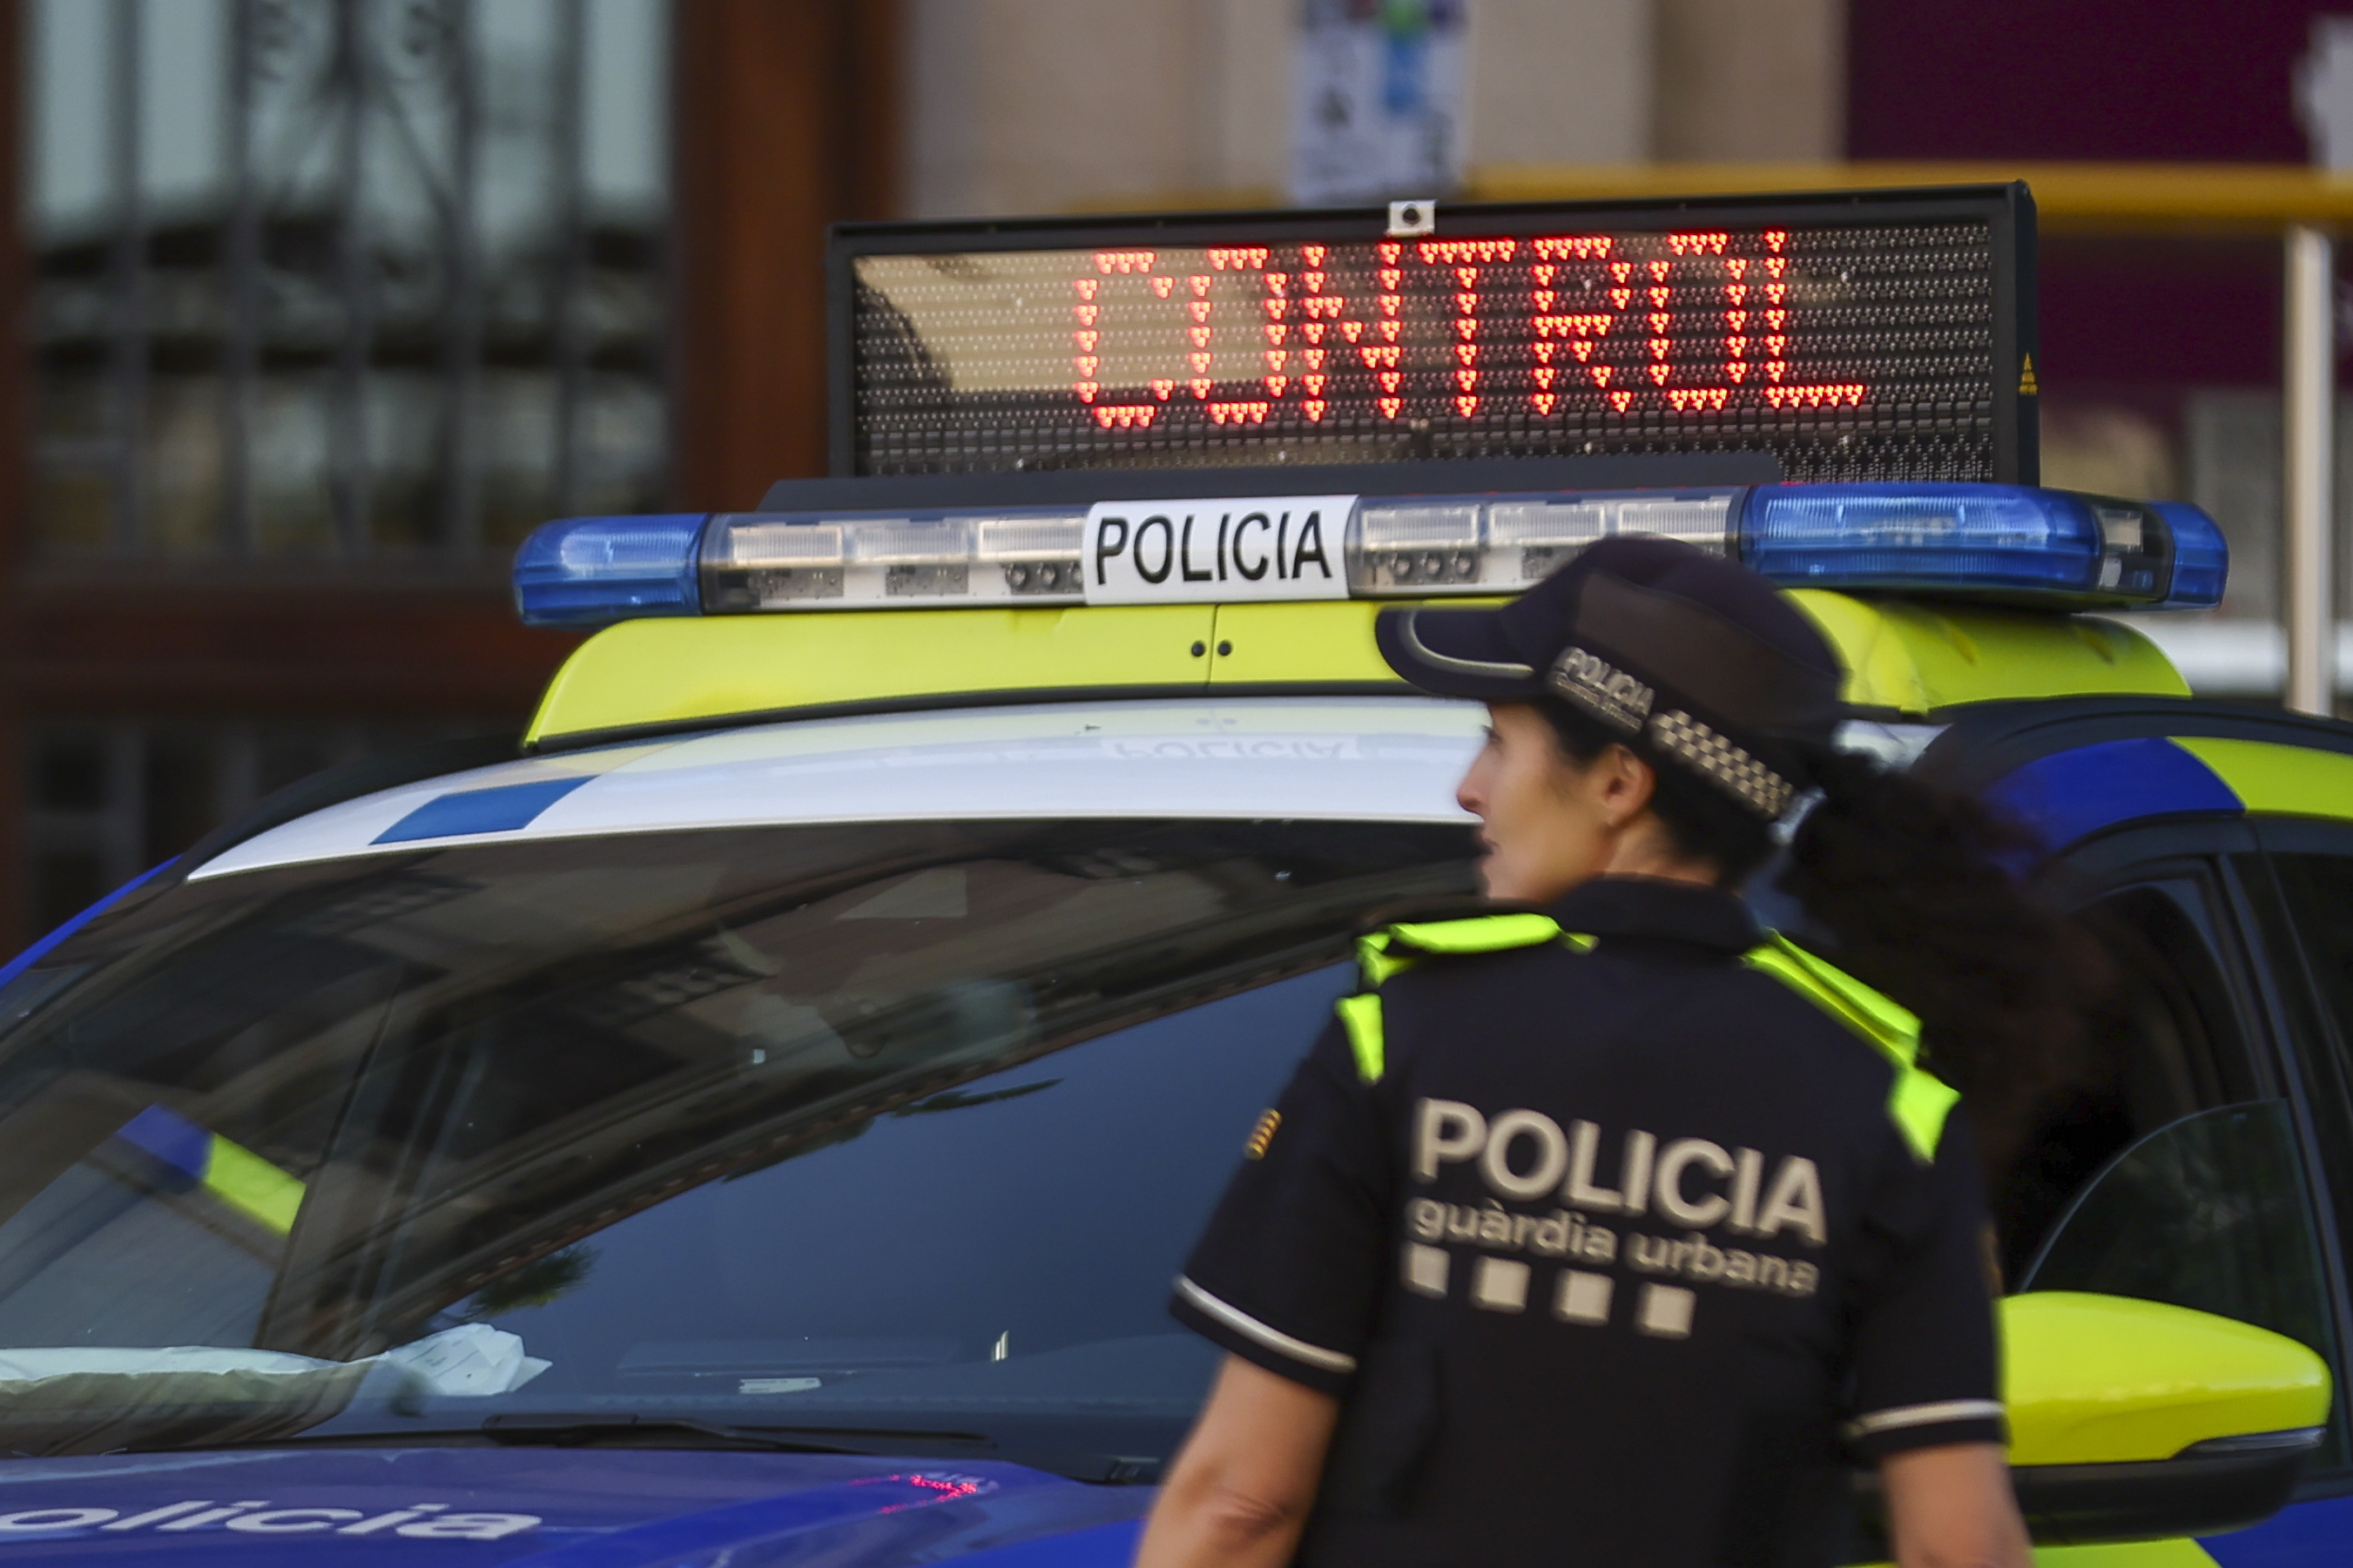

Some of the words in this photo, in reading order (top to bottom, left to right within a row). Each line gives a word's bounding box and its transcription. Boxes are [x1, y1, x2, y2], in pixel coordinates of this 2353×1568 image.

[1075, 230, 1865, 427] CONTROL
[1096, 510, 1332, 585] POLICIA
[1557, 647, 1655, 717] POLICIA
[1412, 1097, 1827, 1247] POLICIA
[1407, 1196, 1617, 1264] guàrdia
[1626, 1231, 1820, 1297] urbana
